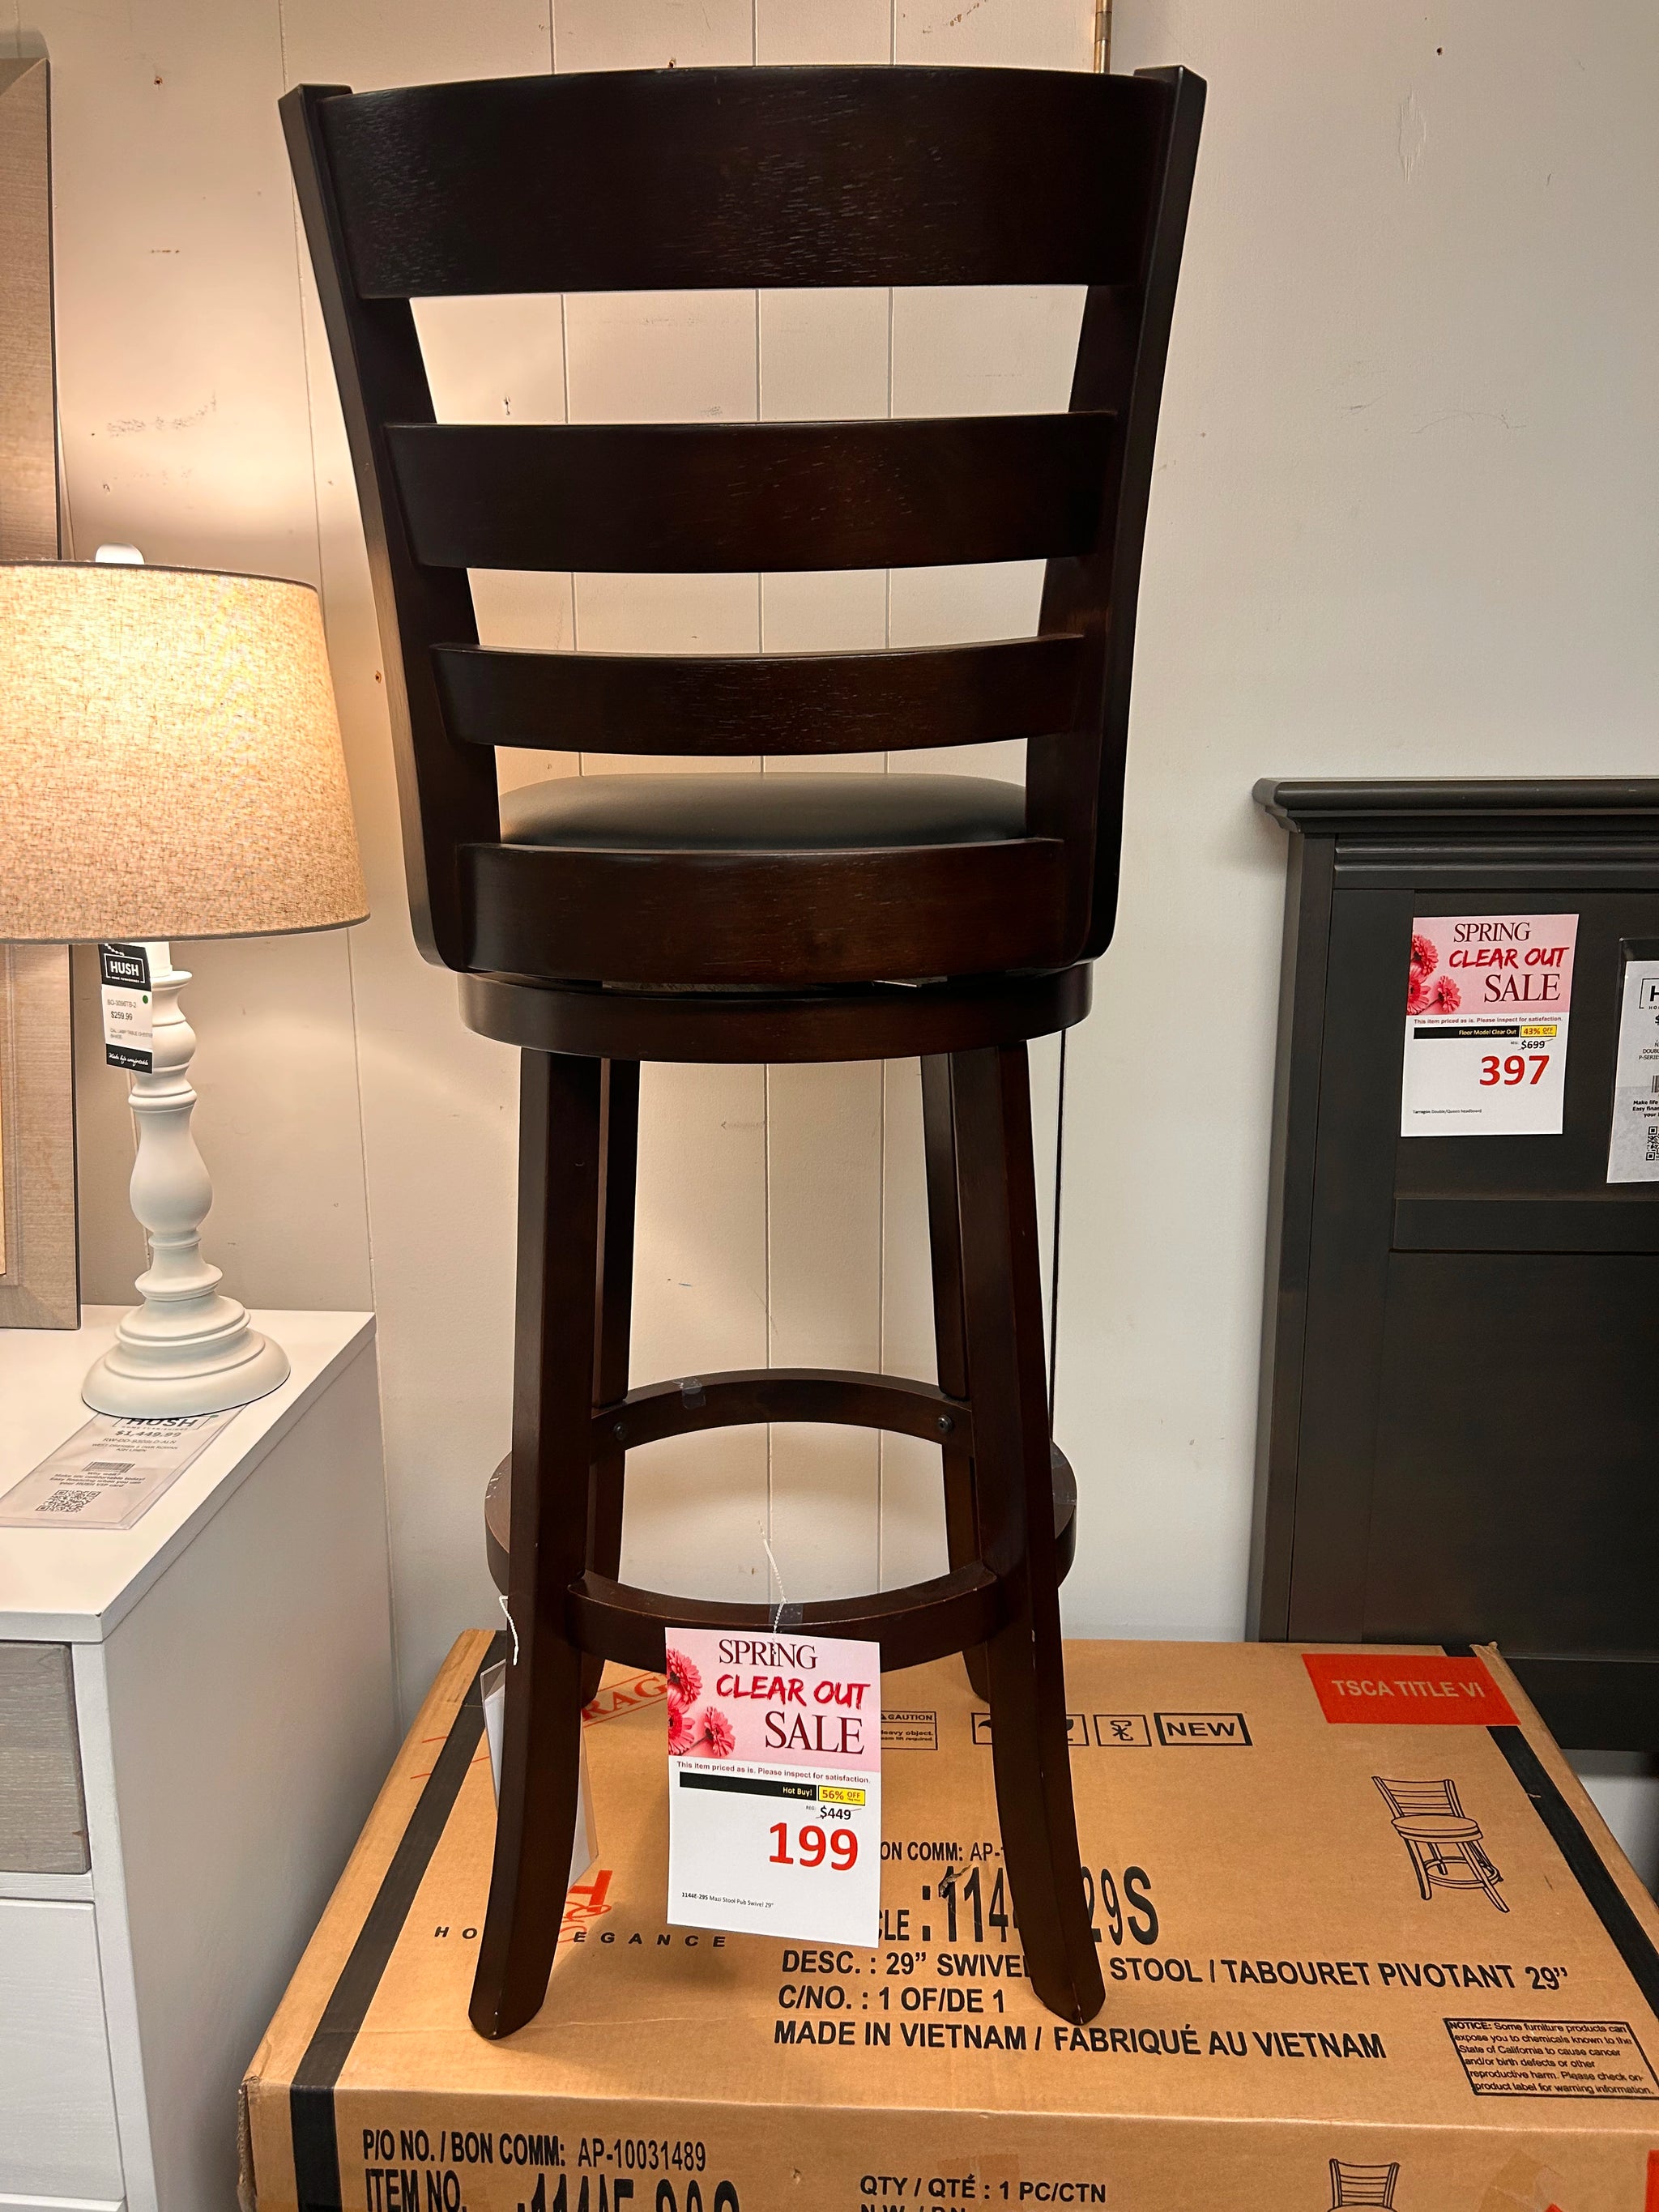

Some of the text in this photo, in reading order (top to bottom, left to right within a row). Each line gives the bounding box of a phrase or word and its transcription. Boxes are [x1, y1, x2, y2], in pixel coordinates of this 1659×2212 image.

[1453, 922, 1531, 943] SPRING
[1448, 947, 1570, 970] CLEAR OUT
[110, 961, 139, 976] HUSH
[1484, 974, 1561, 1003] SALE
[111, 1011, 133, 1021] $259.99
[1521, 1040, 1546, 1050] $699
[1479, 1055, 1550, 1087] 397
[719, 1639, 817, 1669] SPRING
[716, 1674, 871, 1711] CLEAR OUT
[1332, 1680, 1485, 1698] TSCA TITLE VI
[765, 1711, 865, 1755] SALE
[1166, 1722, 1236, 1737] NEW
[758, 1767, 782, 1775] Please
[784, 1770, 811, 1779] inspect
[825, 1775, 871, 1784] satisfaction.
[797, 1788, 812, 1797] Buy!
[822, 1790, 844, 1801] 56%
[820, 1805, 851, 1820] $449
[769, 1822, 859, 1871] 199
[881, 1842, 902, 1860] ON
[907, 1842, 963, 1861] COMM:
[782, 1950, 861, 1974] DESC.
[1109, 1957, 1203, 1983] STOOL
[1222, 1959, 1373, 1986] TABOURET
[1377, 1963, 1517, 1988] PIVOTANT
[778, 1984, 852, 2010] C/NO.
[878, 1988, 890, 2010] 1
[901, 1987, 983, 2013] OF/DE
[992, 1989, 1004, 2012] 1
[1449, 2021, 1492, 2030] NOTICE:
[1494, 2022, 1522, 2031] Some
[1524, 2022, 1564, 2032] furniture
[1566, 2024, 1607, 2035] products
[774, 2020, 855, 2045] MADE
[864, 2022, 891, 2047] IN
[899, 2023, 1027, 2050] VIETNAM
[1054, 2023, 1201, 2056] FABRIQUÉ
[1208, 2031, 1247, 2056] AU
[1252, 2031, 1387, 2059] VIETNAM
[1454, 2035, 1488, 2043] expose
[1491, 2035, 1508, 2044] you
[1510, 2035, 1520, 2043] to
[1521, 2035, 1568, 2044] chemicals
[1571, 2036, 1603, 2044] known
[1459, 2045, 1484, 2054] State
[1486, 2046, 1496, 2054] of
[1499, 2046, 1542, 2055] California
[1465, 2057, 1494, 2065] and/or
[1496, 2058, 1518, 2066] birth
[1520, 2058, 1555, 2067] defects
[1570, 2060, 1596, 2068] other
[1469, 2070, 1529, 2080] reproductive
[1531, 2070, 1559, 2079] harm.
[1561, 2071, 1595, 2081] Please
[1597, 2073, 1627, 2082] check
[1476, 2082, 1654, 2095] product label for warning information.
[362, 2129, 395, 2161] P/O
[400, 2130, 435, 2162] NO.
[450, 2131, 493, 2163] BON
[498, 2133, 566, 2167] COMM:
[578, 2137, 706, 2172] AP-10031489
[365, 2168, 418, 2212] ITEM
[425, 2170, 467, 2212] NO.
[860, 2176, 908, 2197] QTY
[928, 2173, 975, 2198] QTÉ
[1000, 2180, 1009, 2200] 1
[1019, 2181, 1107, 2203] PC/CTN
